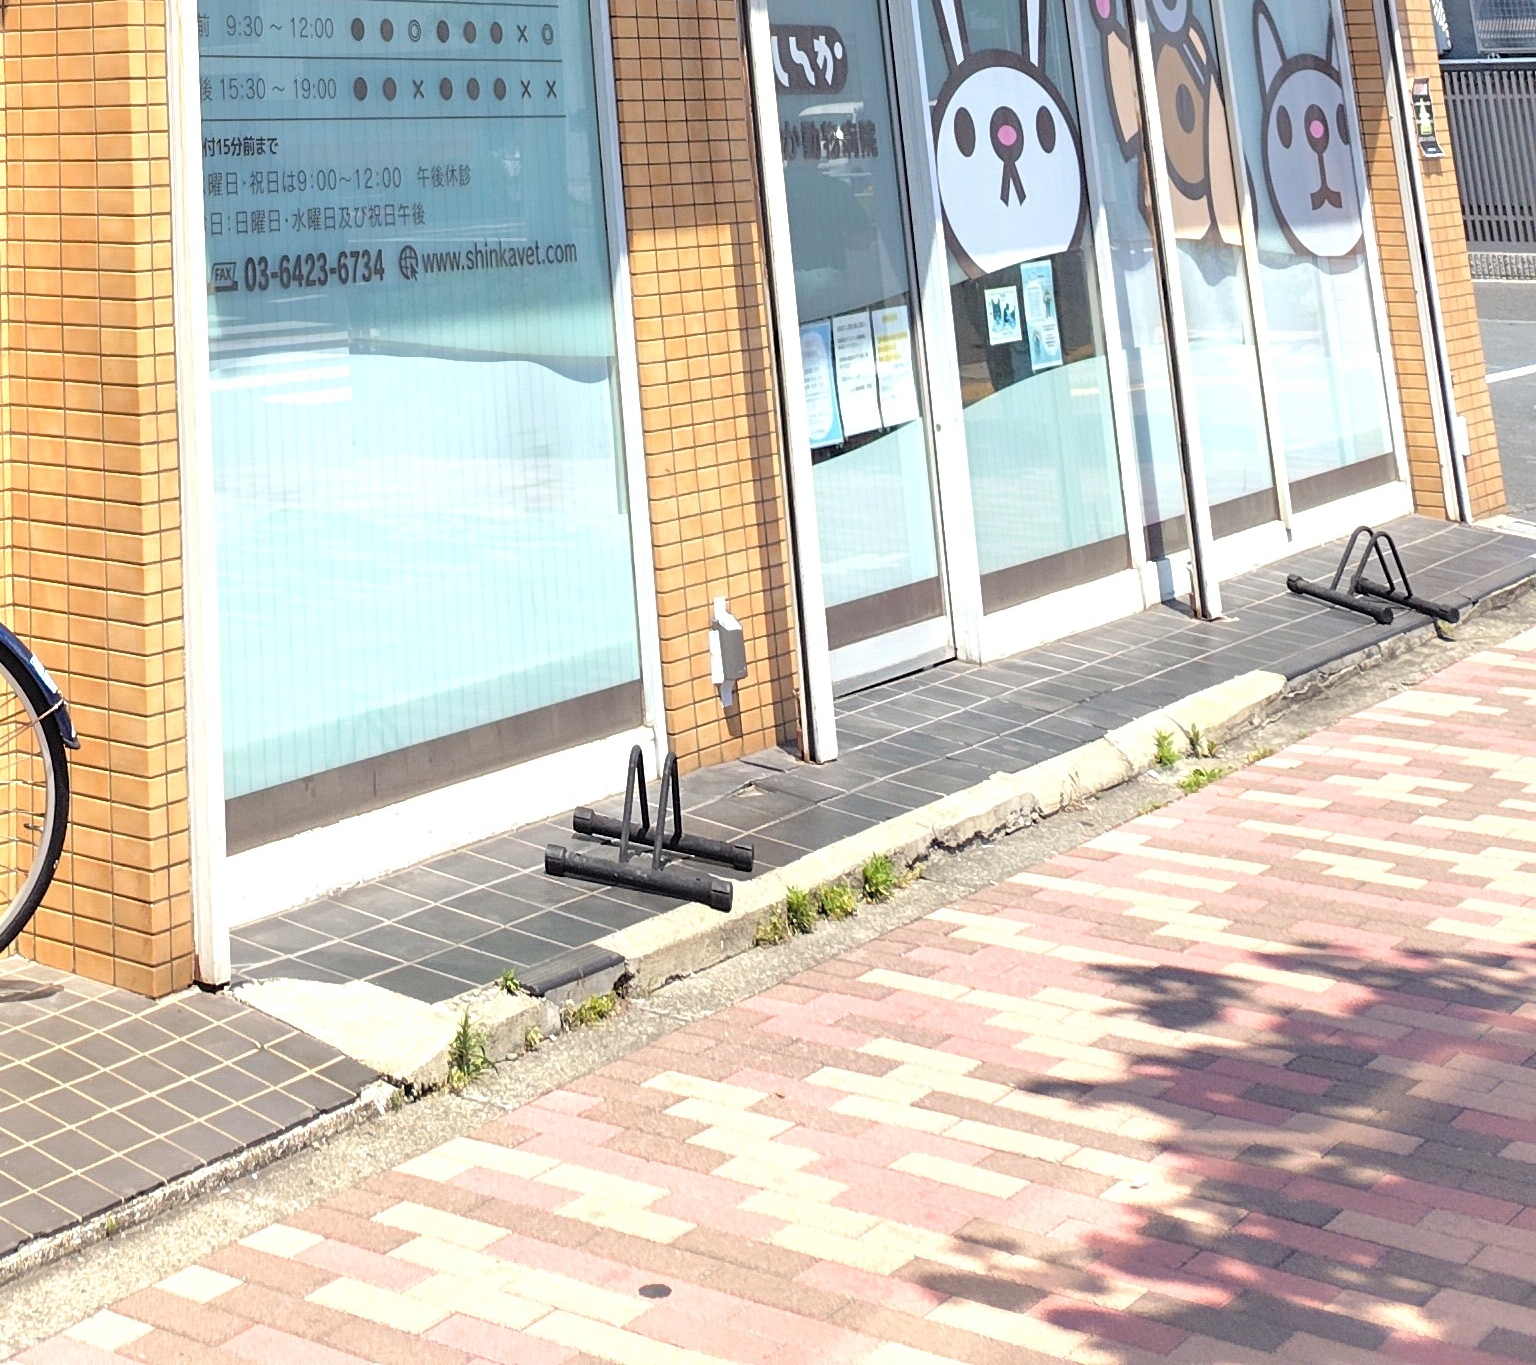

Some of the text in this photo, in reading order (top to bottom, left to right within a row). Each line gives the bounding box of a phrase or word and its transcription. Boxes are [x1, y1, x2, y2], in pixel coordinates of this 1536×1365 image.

[204, 167, 402, 197] 曜日・祝日は9:00～12:00
[205, 202, 426, 237] 日：日曜日・水曜日及び祝日午後
[215, 239, 578, 292] FAX 03-6423-6734 www.shinkavet.com
